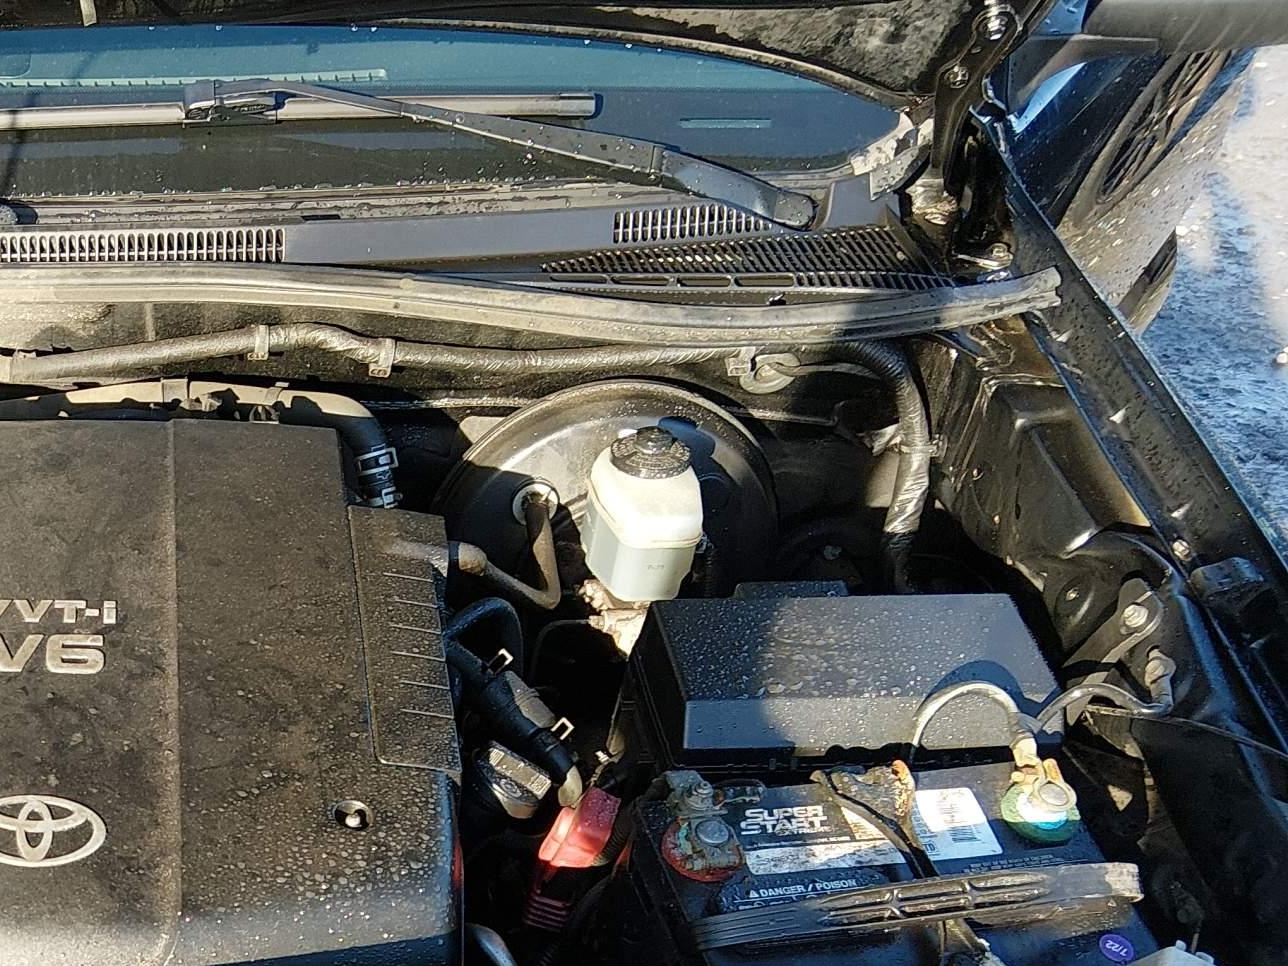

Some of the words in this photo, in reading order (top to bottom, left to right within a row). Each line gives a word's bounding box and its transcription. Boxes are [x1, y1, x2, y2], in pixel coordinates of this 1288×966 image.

[744, 805, 824, 822] SUPER
[740, 815, 828, 835] START
[759, 884, 807, 898] DANGER
[817, 878, 857, 891] POISON
